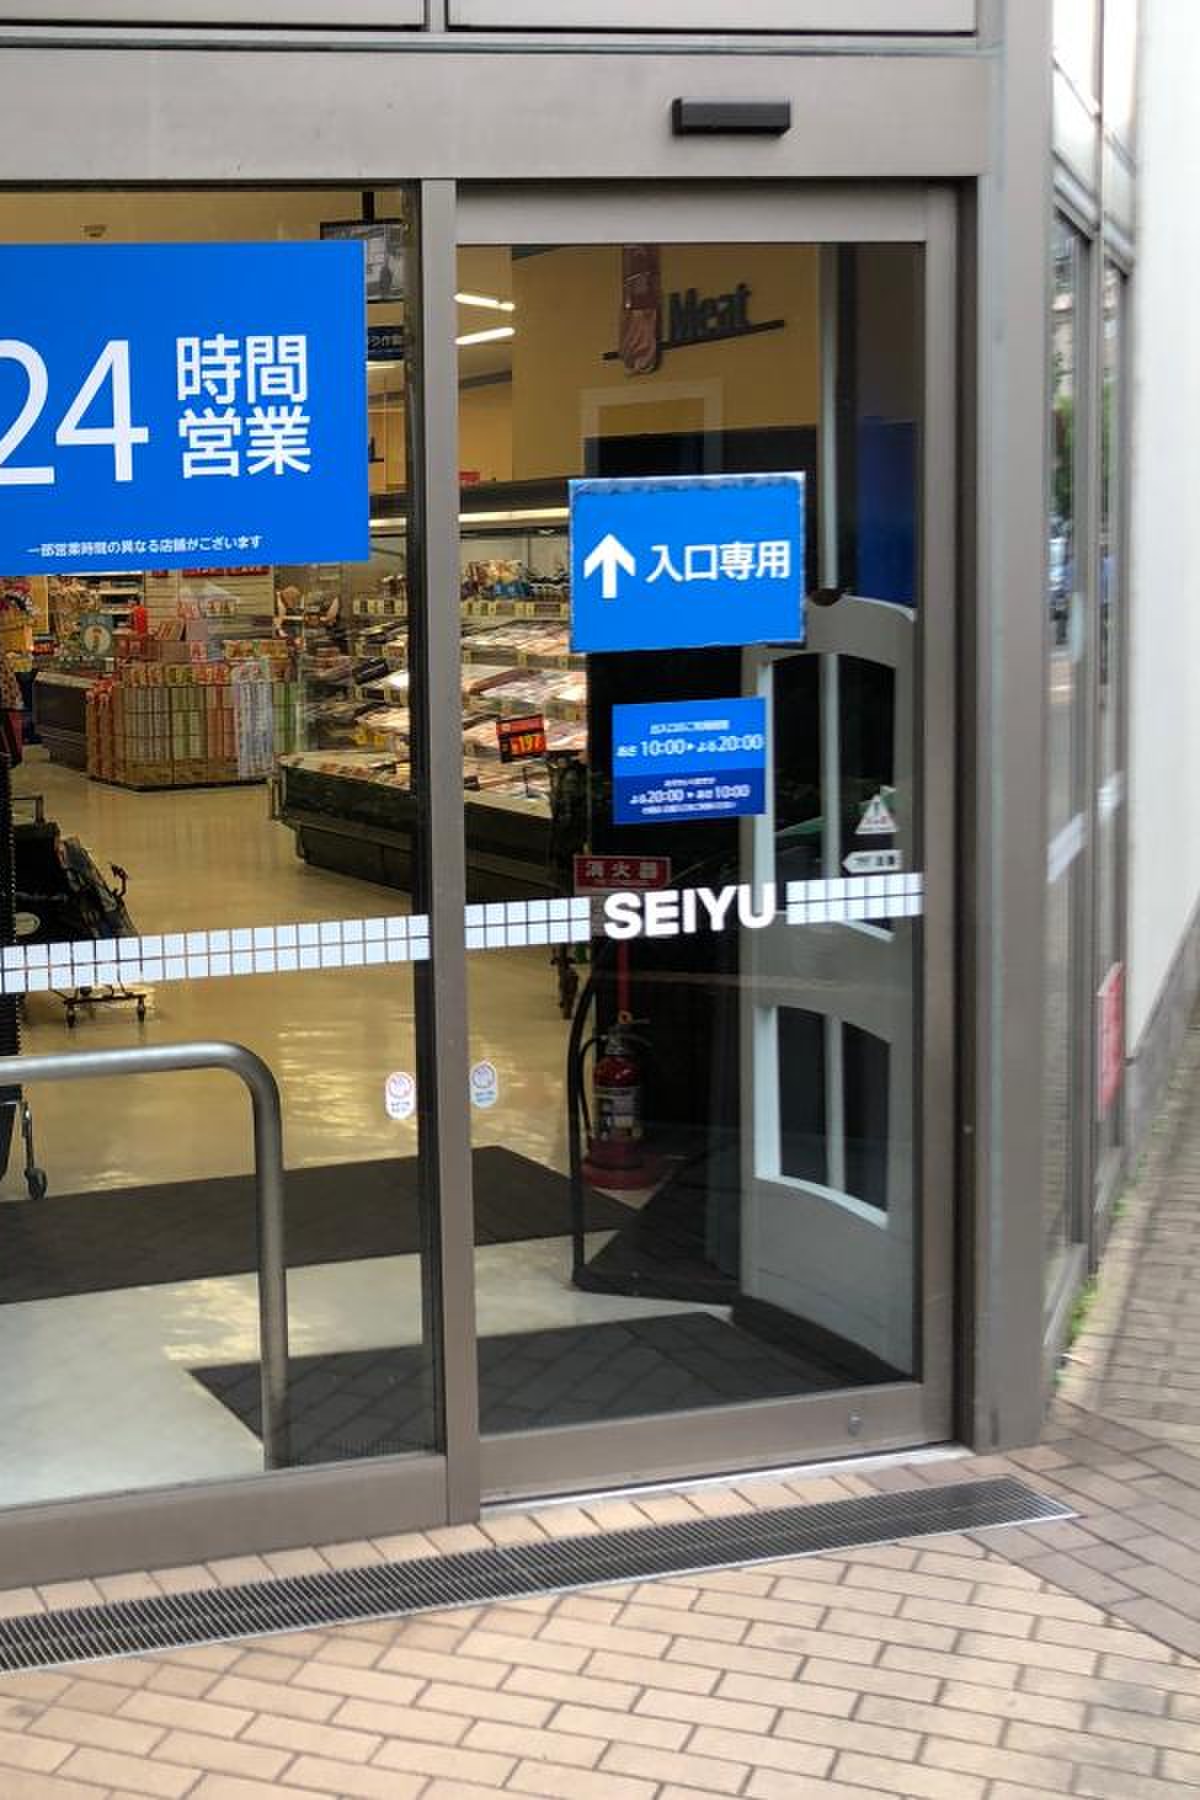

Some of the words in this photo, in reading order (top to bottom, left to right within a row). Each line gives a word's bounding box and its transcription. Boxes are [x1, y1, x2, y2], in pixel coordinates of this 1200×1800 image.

[670, 283, 752, 339] Meat
[175, 334, 308, 404] 時間
[178, 406, 311, 479] 営業
[646, 541, 792, 583] 入口専用
[603, 882, 776, 940] SEIYU
